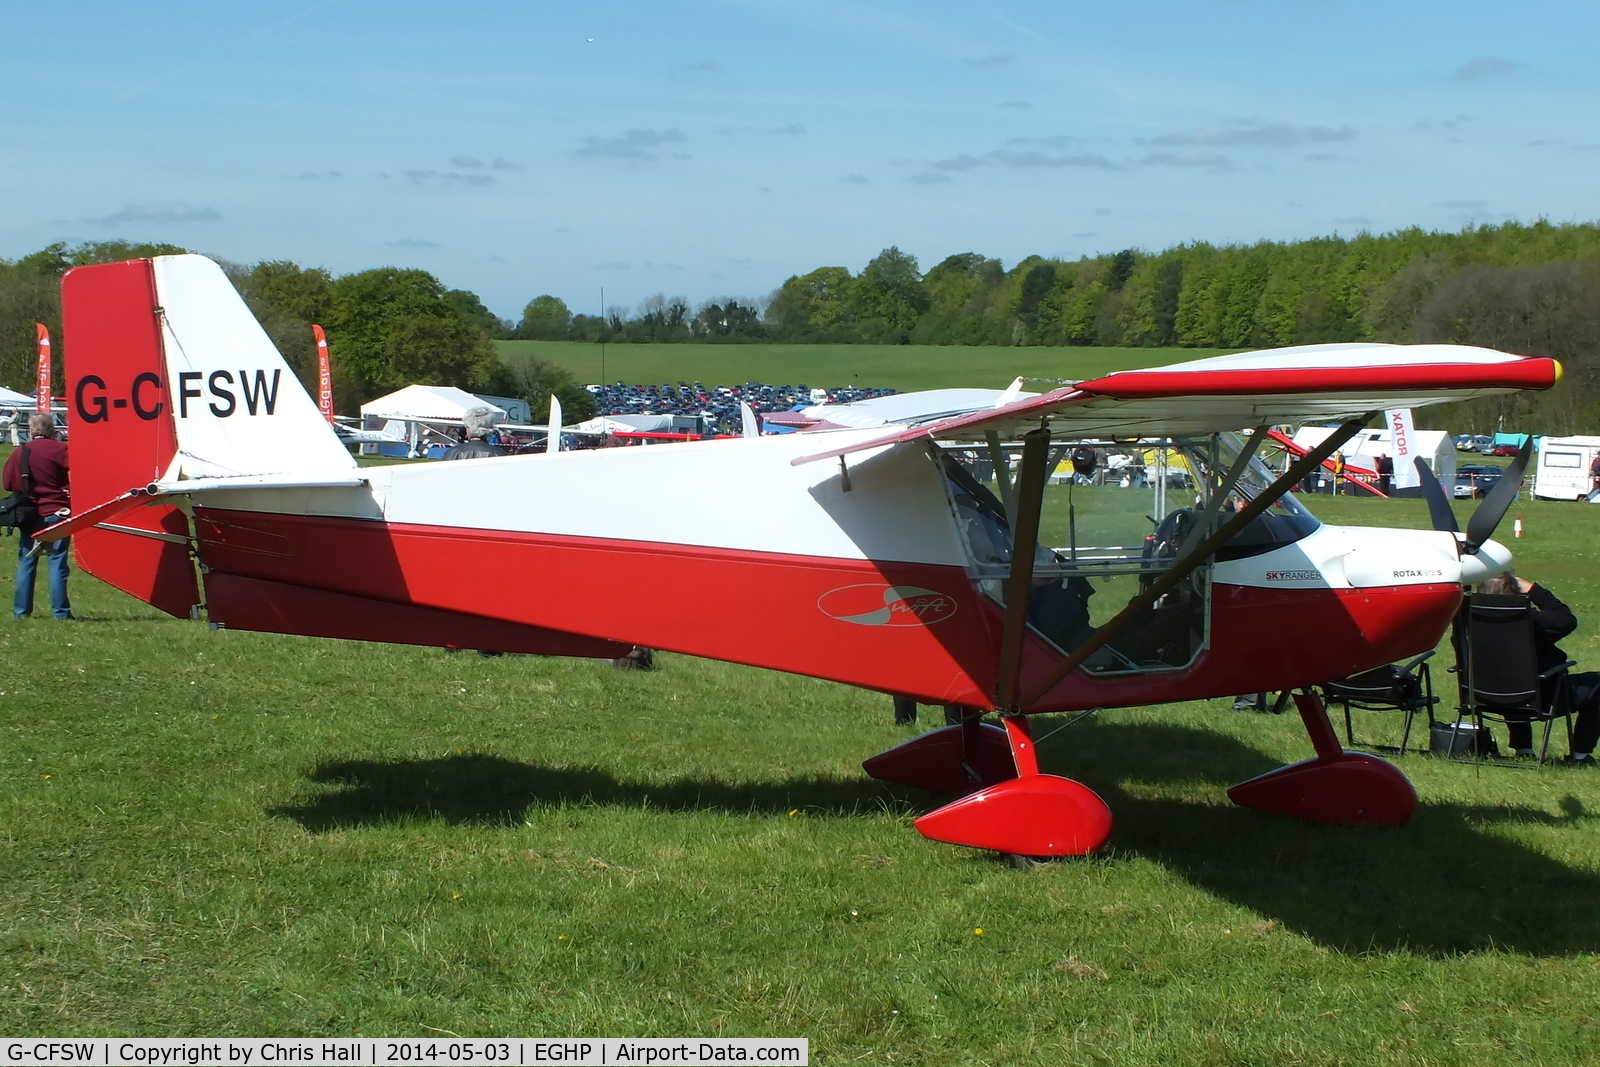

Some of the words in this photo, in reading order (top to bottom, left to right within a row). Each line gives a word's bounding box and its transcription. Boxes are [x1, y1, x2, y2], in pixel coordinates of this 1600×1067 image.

[75, 368, 281, 423] G-CFSW
[1266, 571, 1322, 580] SKYRANGER
[1393, 570, 1423, 578] ROTAX
